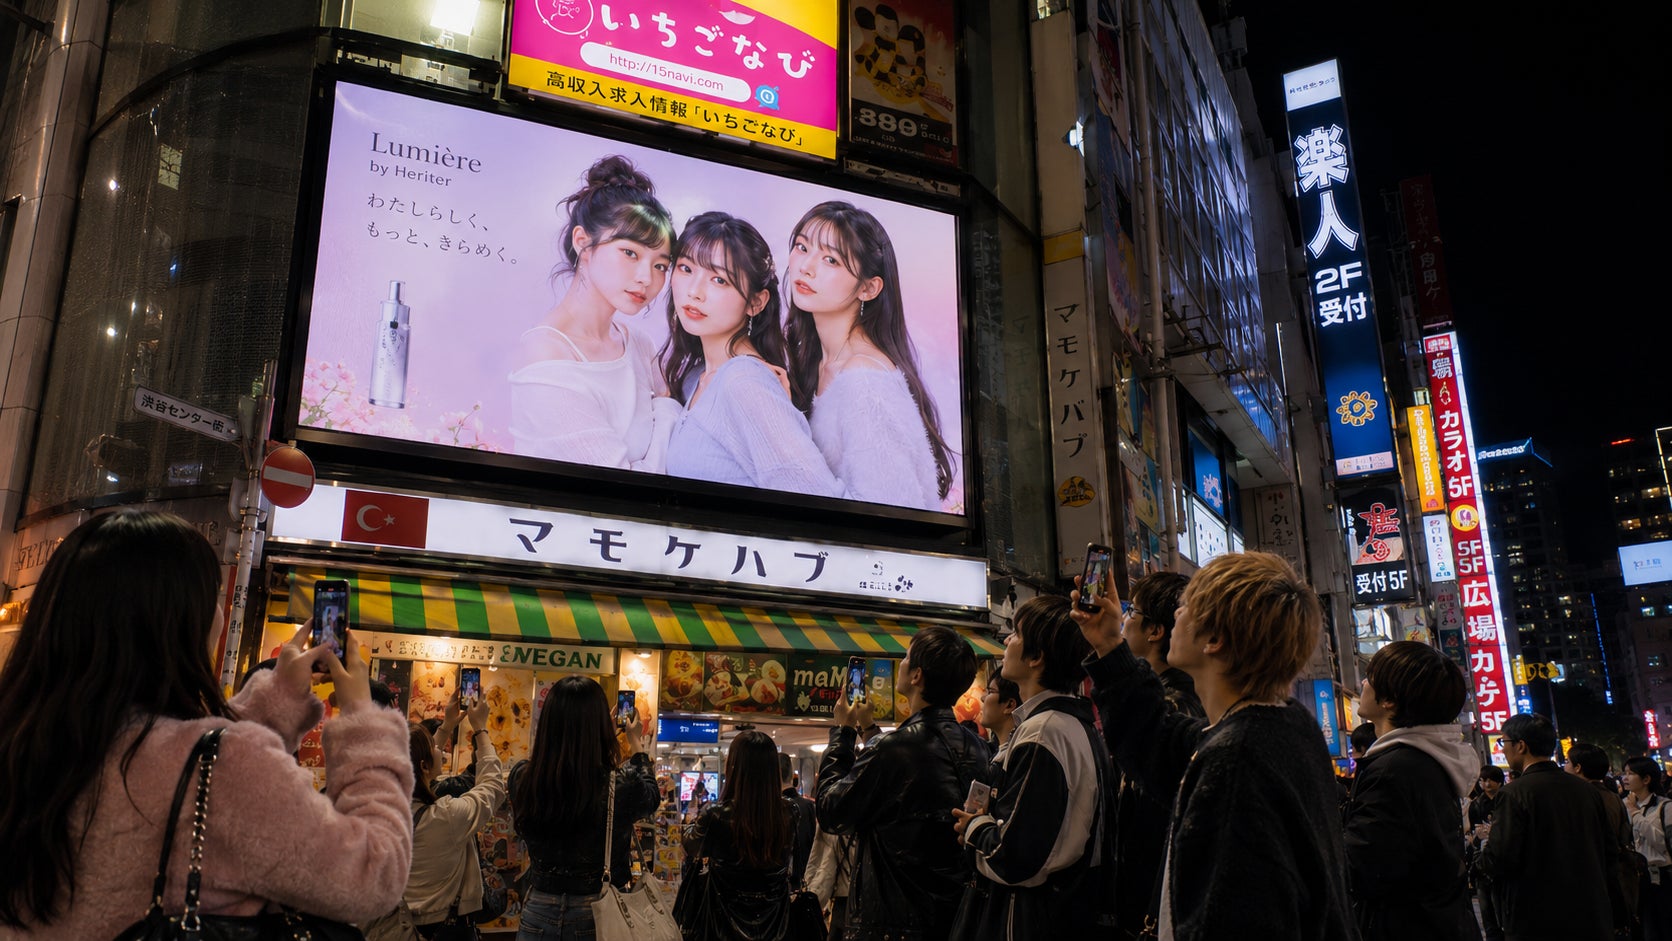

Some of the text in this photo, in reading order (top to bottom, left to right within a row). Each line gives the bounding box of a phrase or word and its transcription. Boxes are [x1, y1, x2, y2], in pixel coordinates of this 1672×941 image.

[601, 4, 816, 79] いちごなび
[609, 53, 724, 91] http://15navi.com
[371, 132, 482, 173] Lumière
[370, 160, 452, 187] by Heriter
[367, 193, 488, 232] わたしらしく、
[367, 221, 517, 265] もっと、きらめく。
[1315, 261, 1363, 295] 2F
[1319, 292, 1367, 328] 受付
[1448, 474, 1473, 499] 5F
